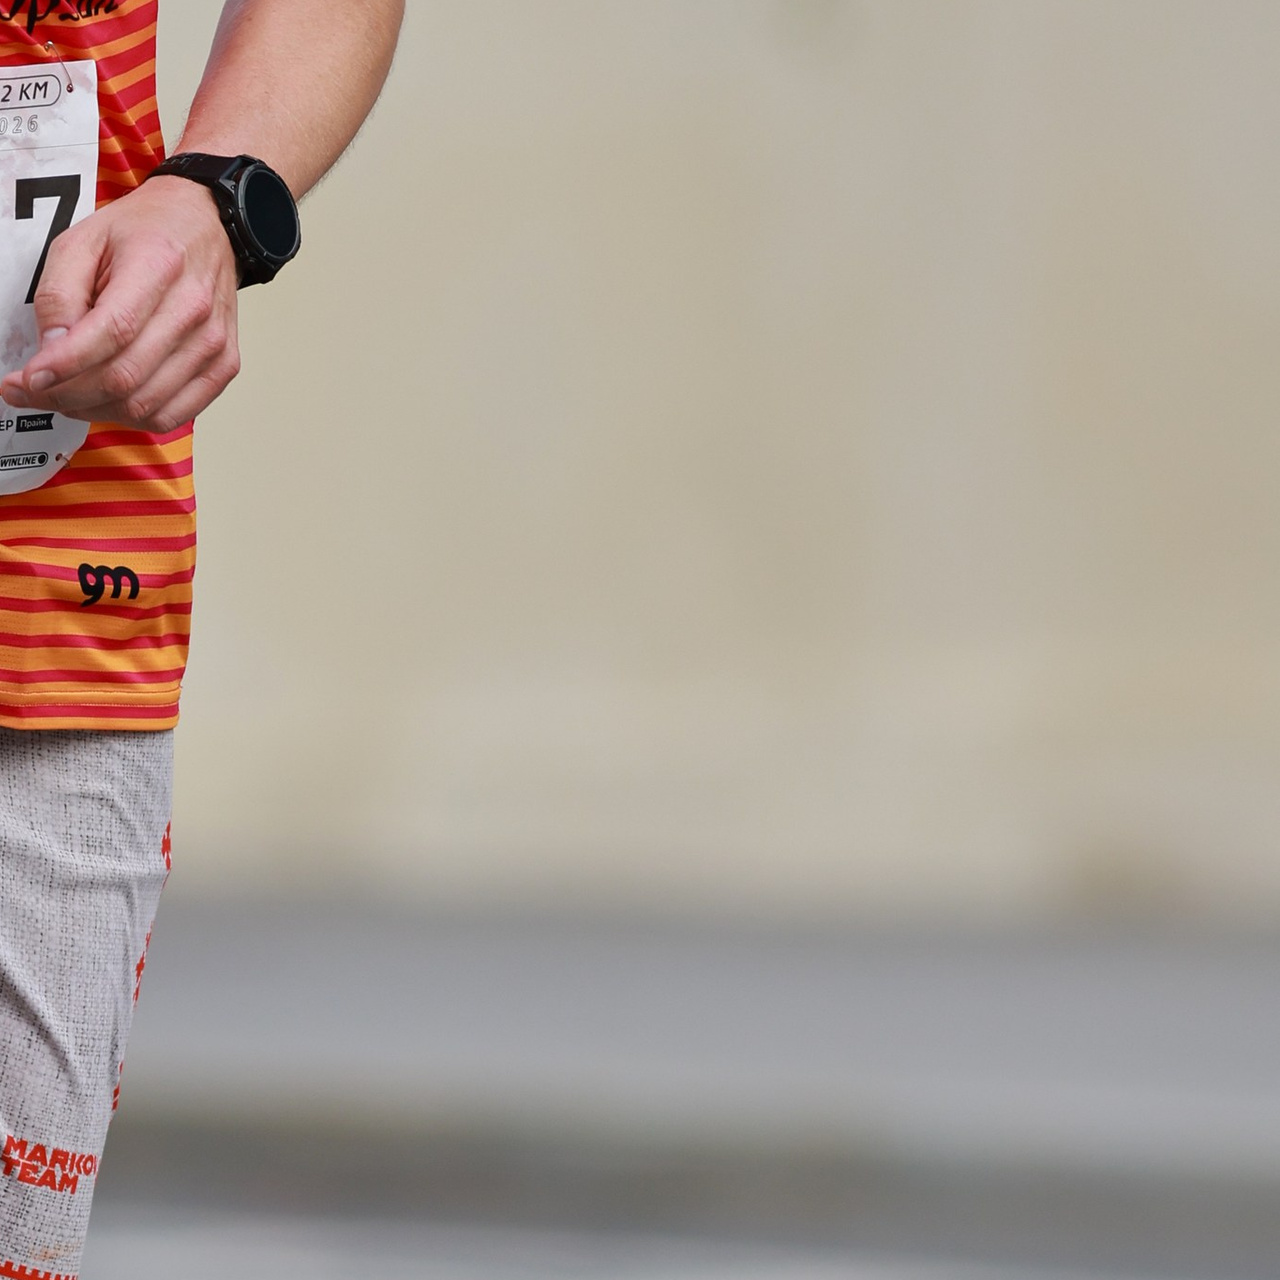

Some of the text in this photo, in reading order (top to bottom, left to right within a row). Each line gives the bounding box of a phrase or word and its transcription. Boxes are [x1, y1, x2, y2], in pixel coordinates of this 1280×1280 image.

[19, 81, 49, 101] КМ
[20, 417, 48, 429] Прайм
[0, 456, 37, 468] WINLINE
[3, 1134, 97, 1176] MARKO
[0, 1154, 79, 1195] TEAM
